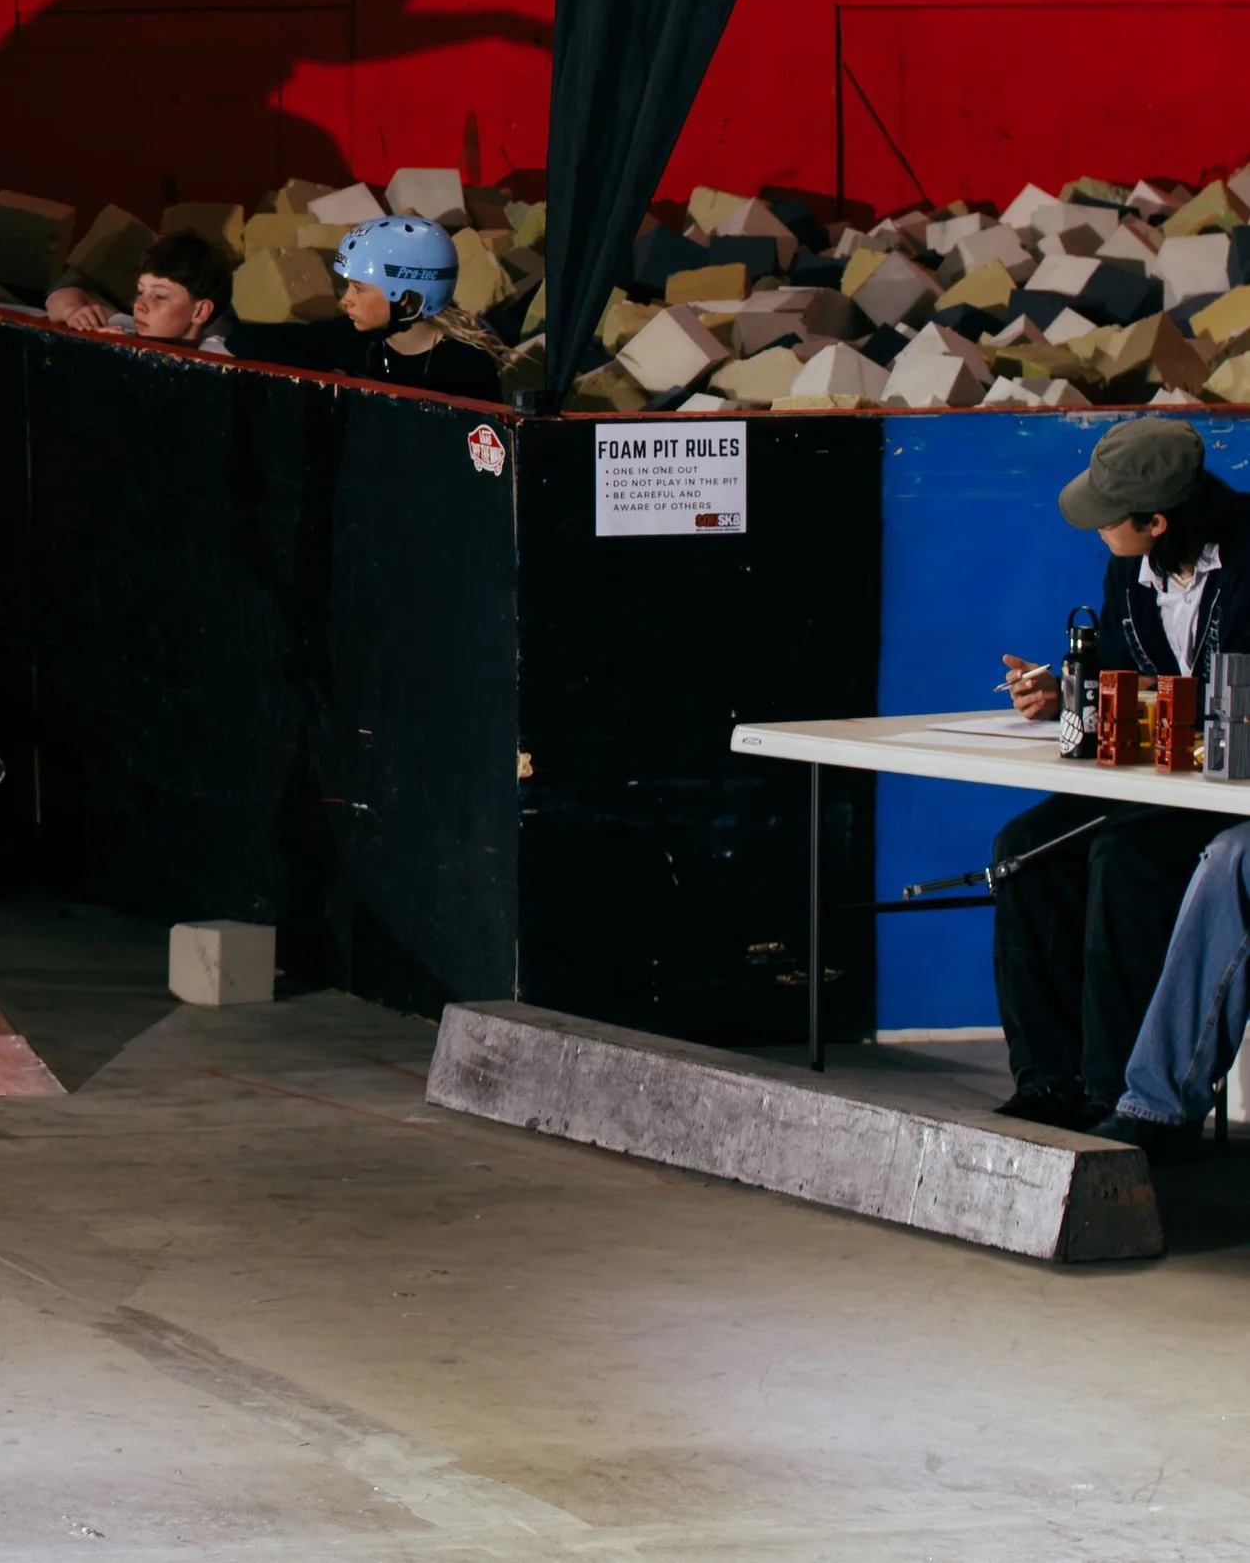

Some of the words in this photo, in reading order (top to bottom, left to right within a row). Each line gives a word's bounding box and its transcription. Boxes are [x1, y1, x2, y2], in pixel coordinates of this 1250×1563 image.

[397, 267, 439, 281] Pro-tec
[598, 440, 647, 459] FOAM
[653, 439, 679, 459] PIT
[686, 438, 740, 458] RULES
[612, 467, 634, 475] ONE
[638, 467, 649, 475] IN
[652, 466, 674, 475] ONE
[677, 466, 698, 474] OUT
[613, 479, 628, 488] DO
[631, 479, 652, 487] NOT
[656, 478, 682, 486] PLAY
[685, 477, 696, 486] IN
[699, 477, 719, 485] THE
[723, 477, 739, 485] PIT
[613, 491, 626, 499] BE
[629, 490, 675, 499] CAREFUL
[679, 490, 701, 498] AND
[613, 503, 650, 511] AWARE
[654, 502, 668, 511] OF
[671, 502, 712, 510] OTHERS
